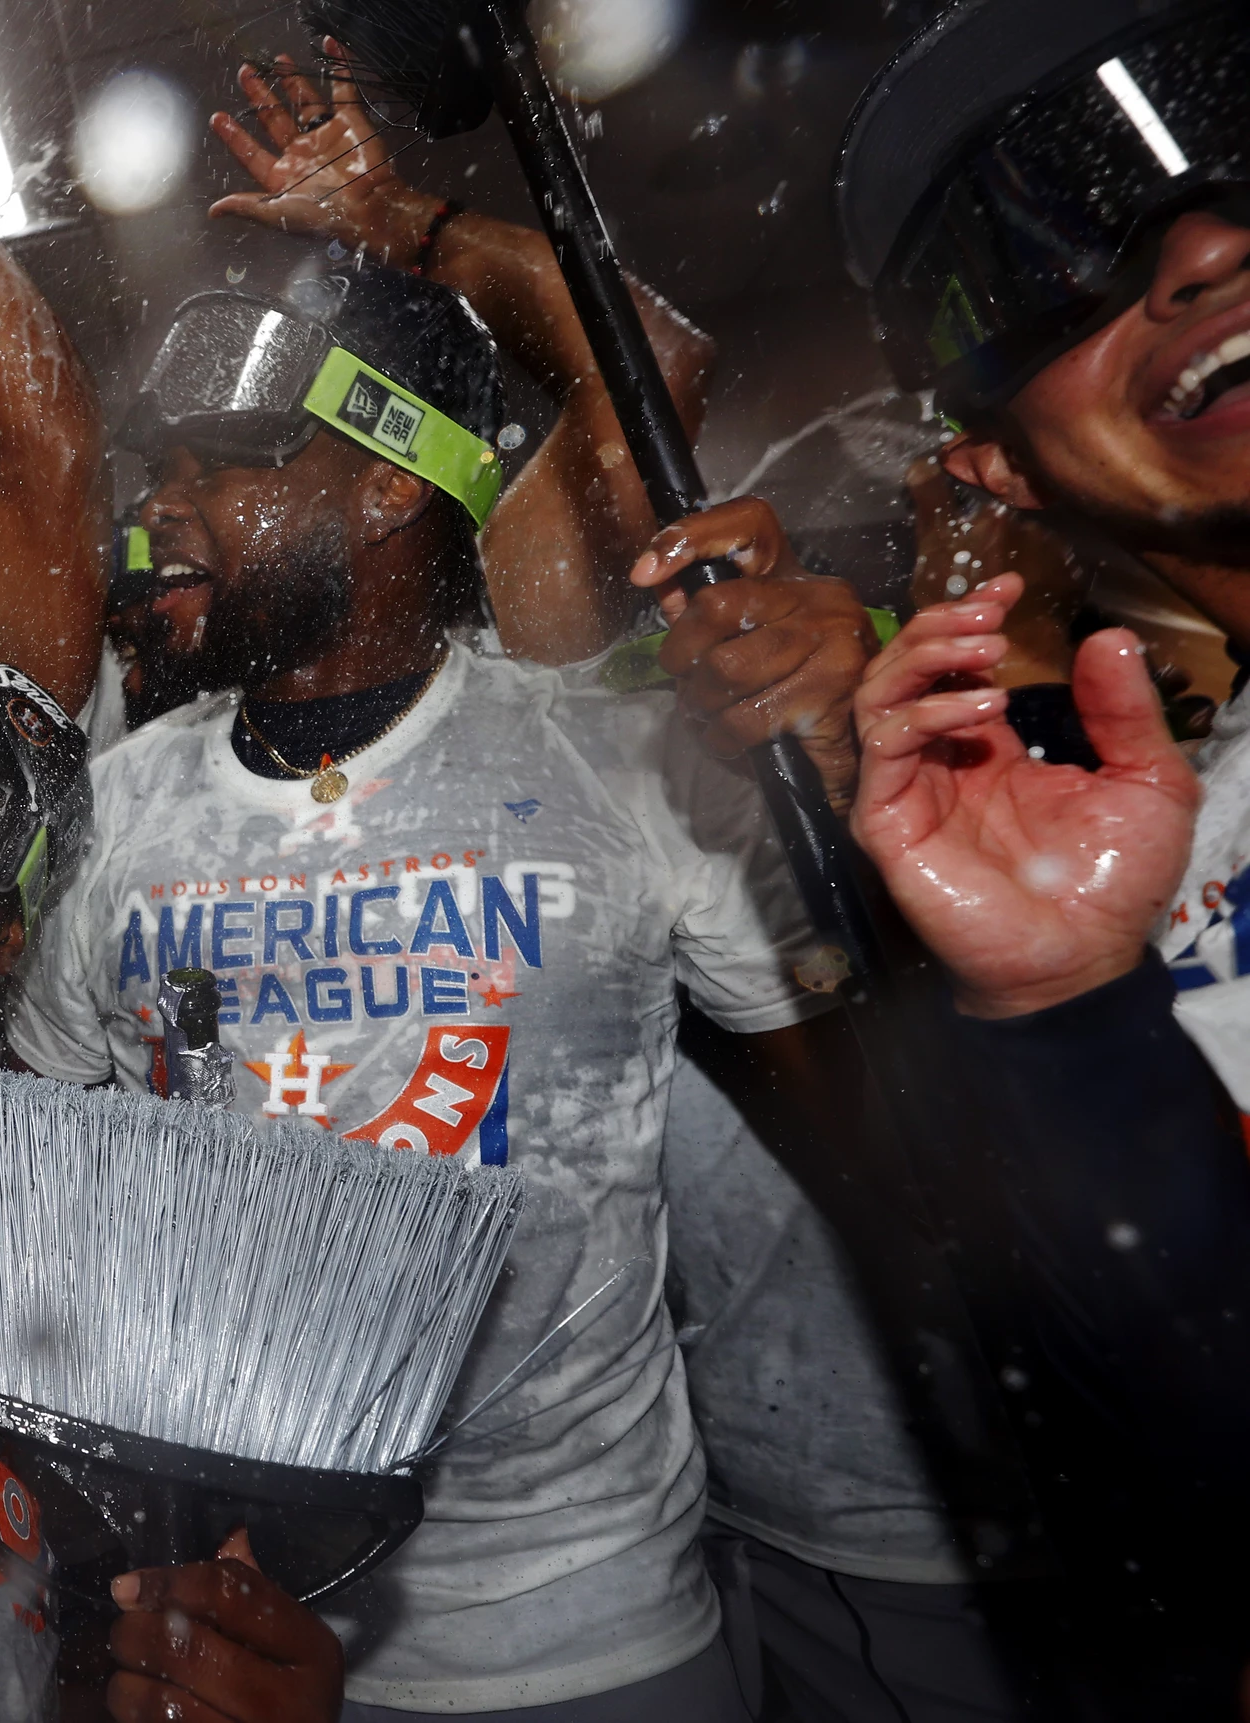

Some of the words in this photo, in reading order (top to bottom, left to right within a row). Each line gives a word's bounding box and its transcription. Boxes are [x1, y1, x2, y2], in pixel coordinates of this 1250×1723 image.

[381, 418, 410, 444] ERA
[388, 405, 416, 431] NEW
[151, 872, 306, 900] HOUSTON
[330, 851, 478, 886] ASTROS
[118, 873, 544, 993] AMERICAN
[214, 964, 471, 1027] EAGUE
